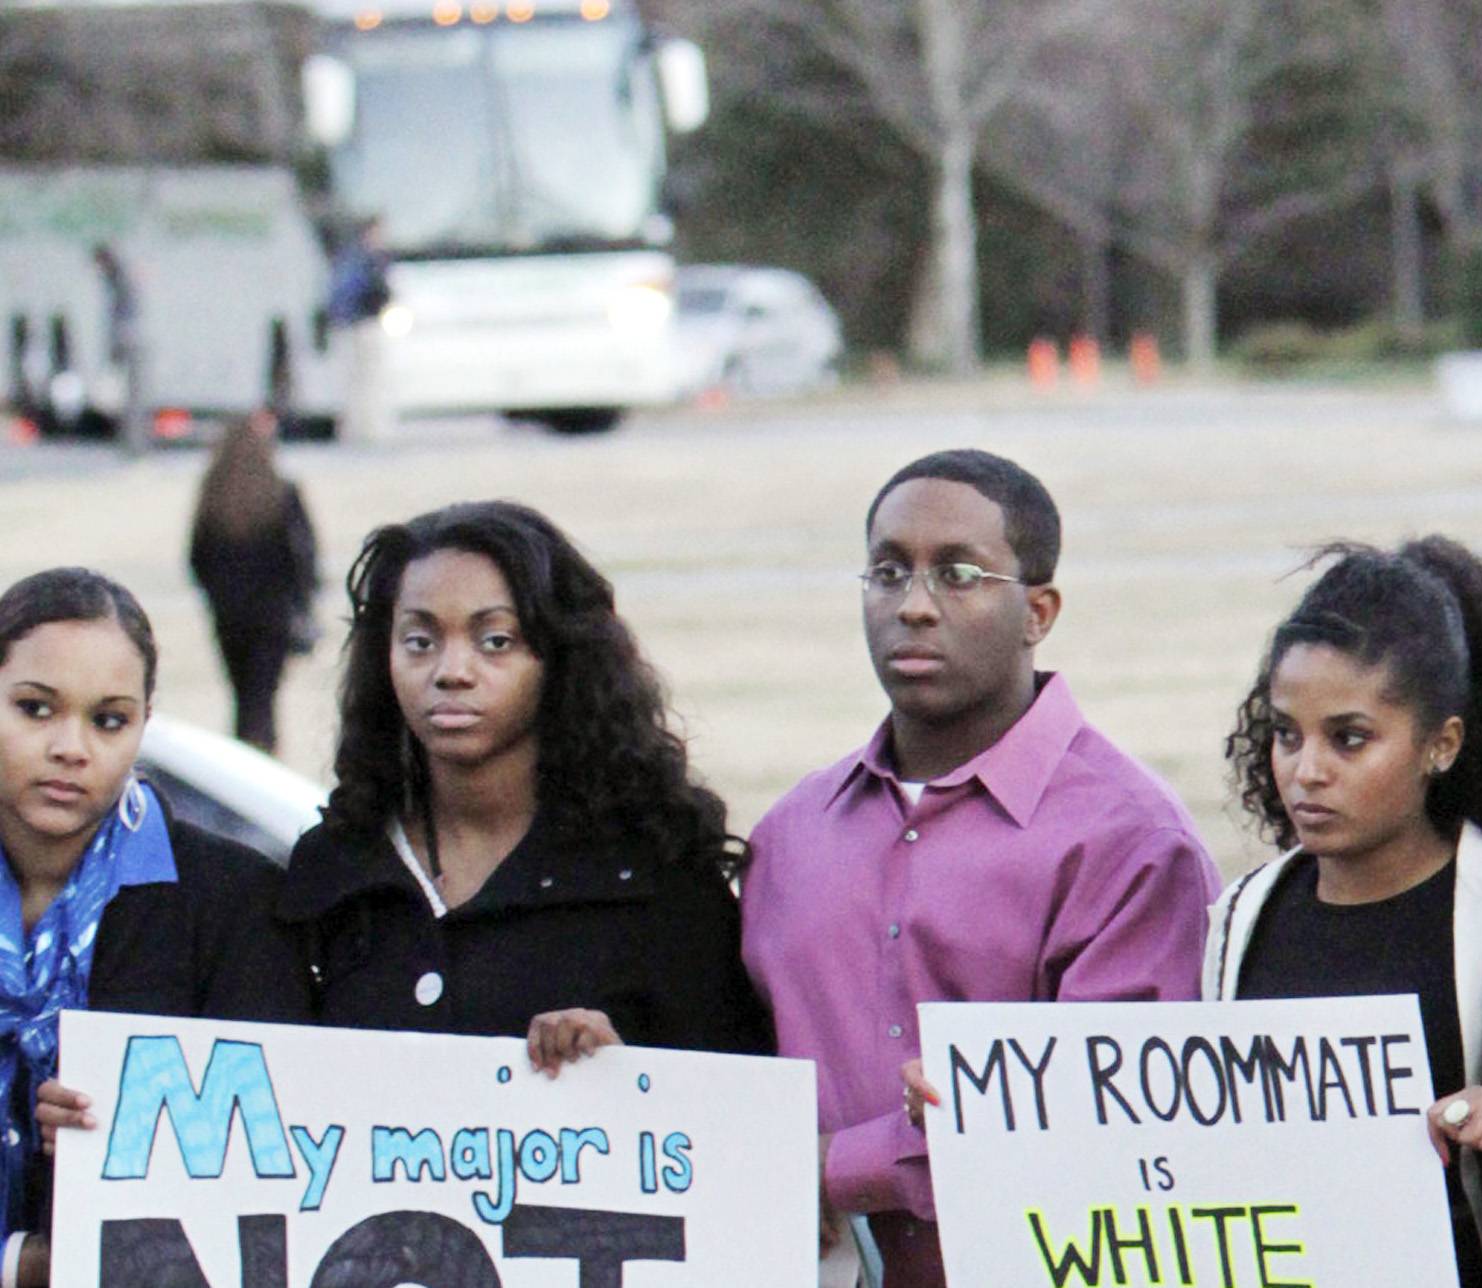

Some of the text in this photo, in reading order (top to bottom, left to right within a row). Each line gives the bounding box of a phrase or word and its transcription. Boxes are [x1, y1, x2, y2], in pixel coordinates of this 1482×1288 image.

[100, 1034, 693, 1224] My major is
[949, 1034, 1422, 1135] MY ROOMMATE
[1139, 1156, 1176, 1191] IS
